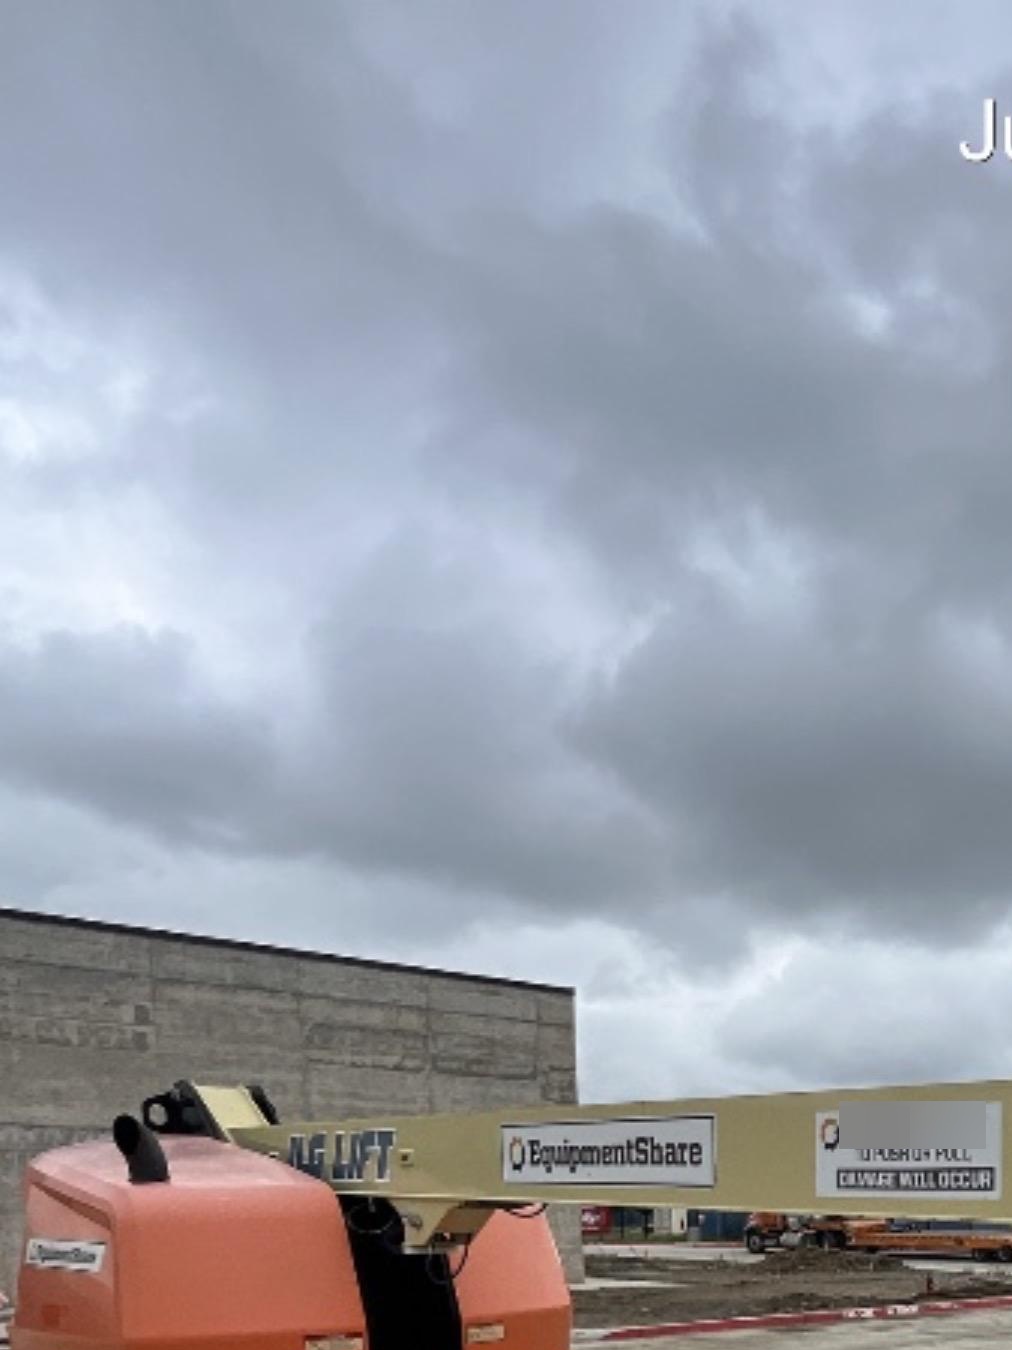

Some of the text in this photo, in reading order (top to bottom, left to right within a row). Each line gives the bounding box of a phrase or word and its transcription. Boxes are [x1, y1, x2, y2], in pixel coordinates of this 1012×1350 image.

[329, 1126, 397, 1183] LIFT
[527, 1136, 704, 1174] EquipmentShare
[898, 1170, 936, 1189] WILL
